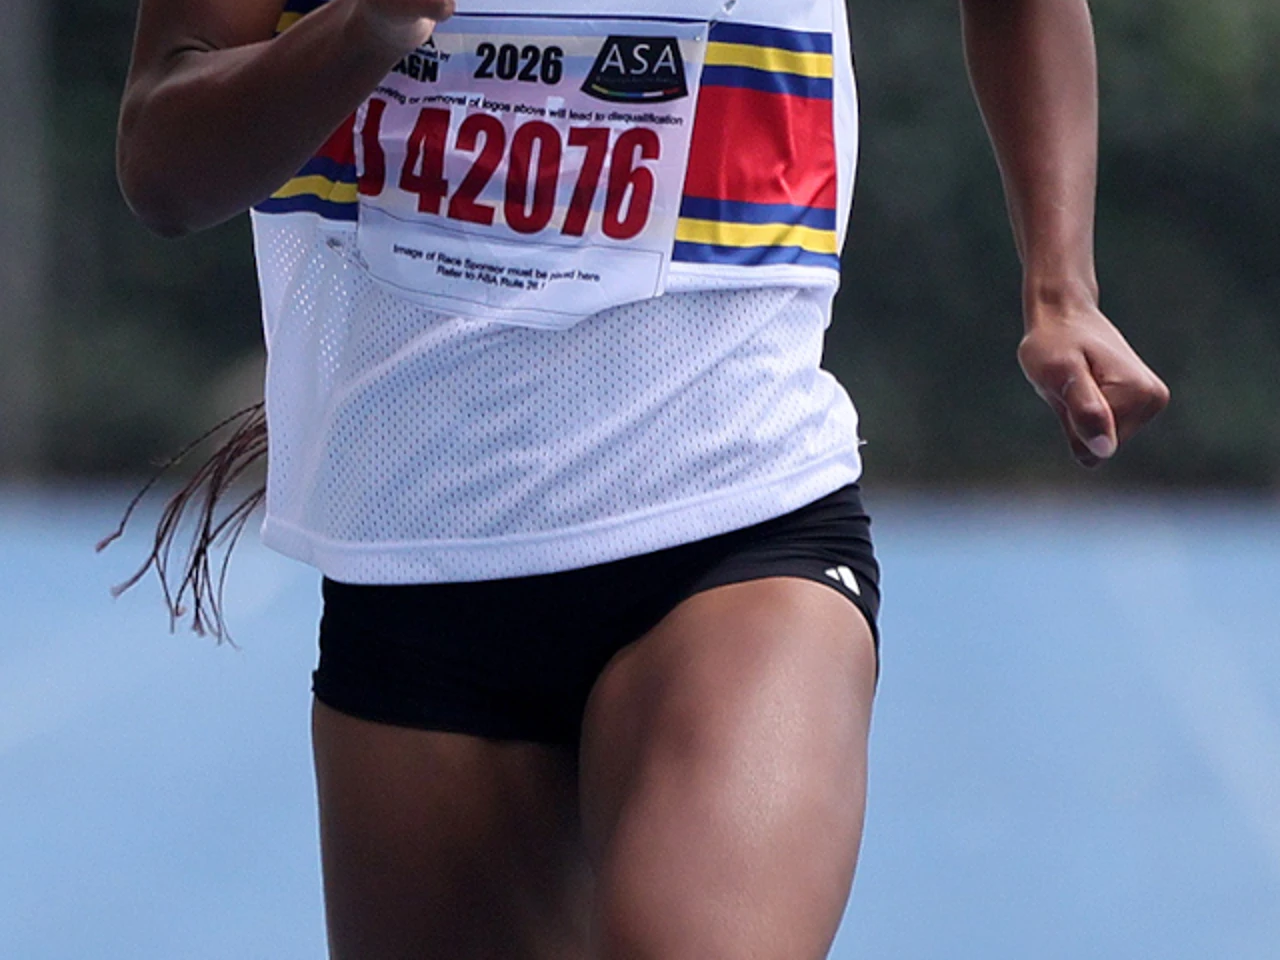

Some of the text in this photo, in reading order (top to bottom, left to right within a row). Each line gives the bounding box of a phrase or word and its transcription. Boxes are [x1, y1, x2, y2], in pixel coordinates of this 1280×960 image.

[473, 41, 564, 86] 2026
[600, 43, 677, 75] ASA
[408, 96, 420, 104] or
[422, 95, 466, 106] removal
[469, 96, 480, 107] of
[482, 98, 511, 112] logos
[513, 103, 546, 117] above
[548, 107, 566, 118] will
[569, 109, 592, 121] lead
[595, 111, 605, 121] to
[608, 111, 683, 126] disqualification
[399, 107, 660, 240] 42076
[393, 244, 423, 259] Image
[426, 250, 437, 260] of
[438, 251, 462, 266] Race
[464, 258, 504, 274] Sponsor
[536, 268, 547, 279] be
[578, 269, 600, 282] here
[465, 271, 475, 280] to
